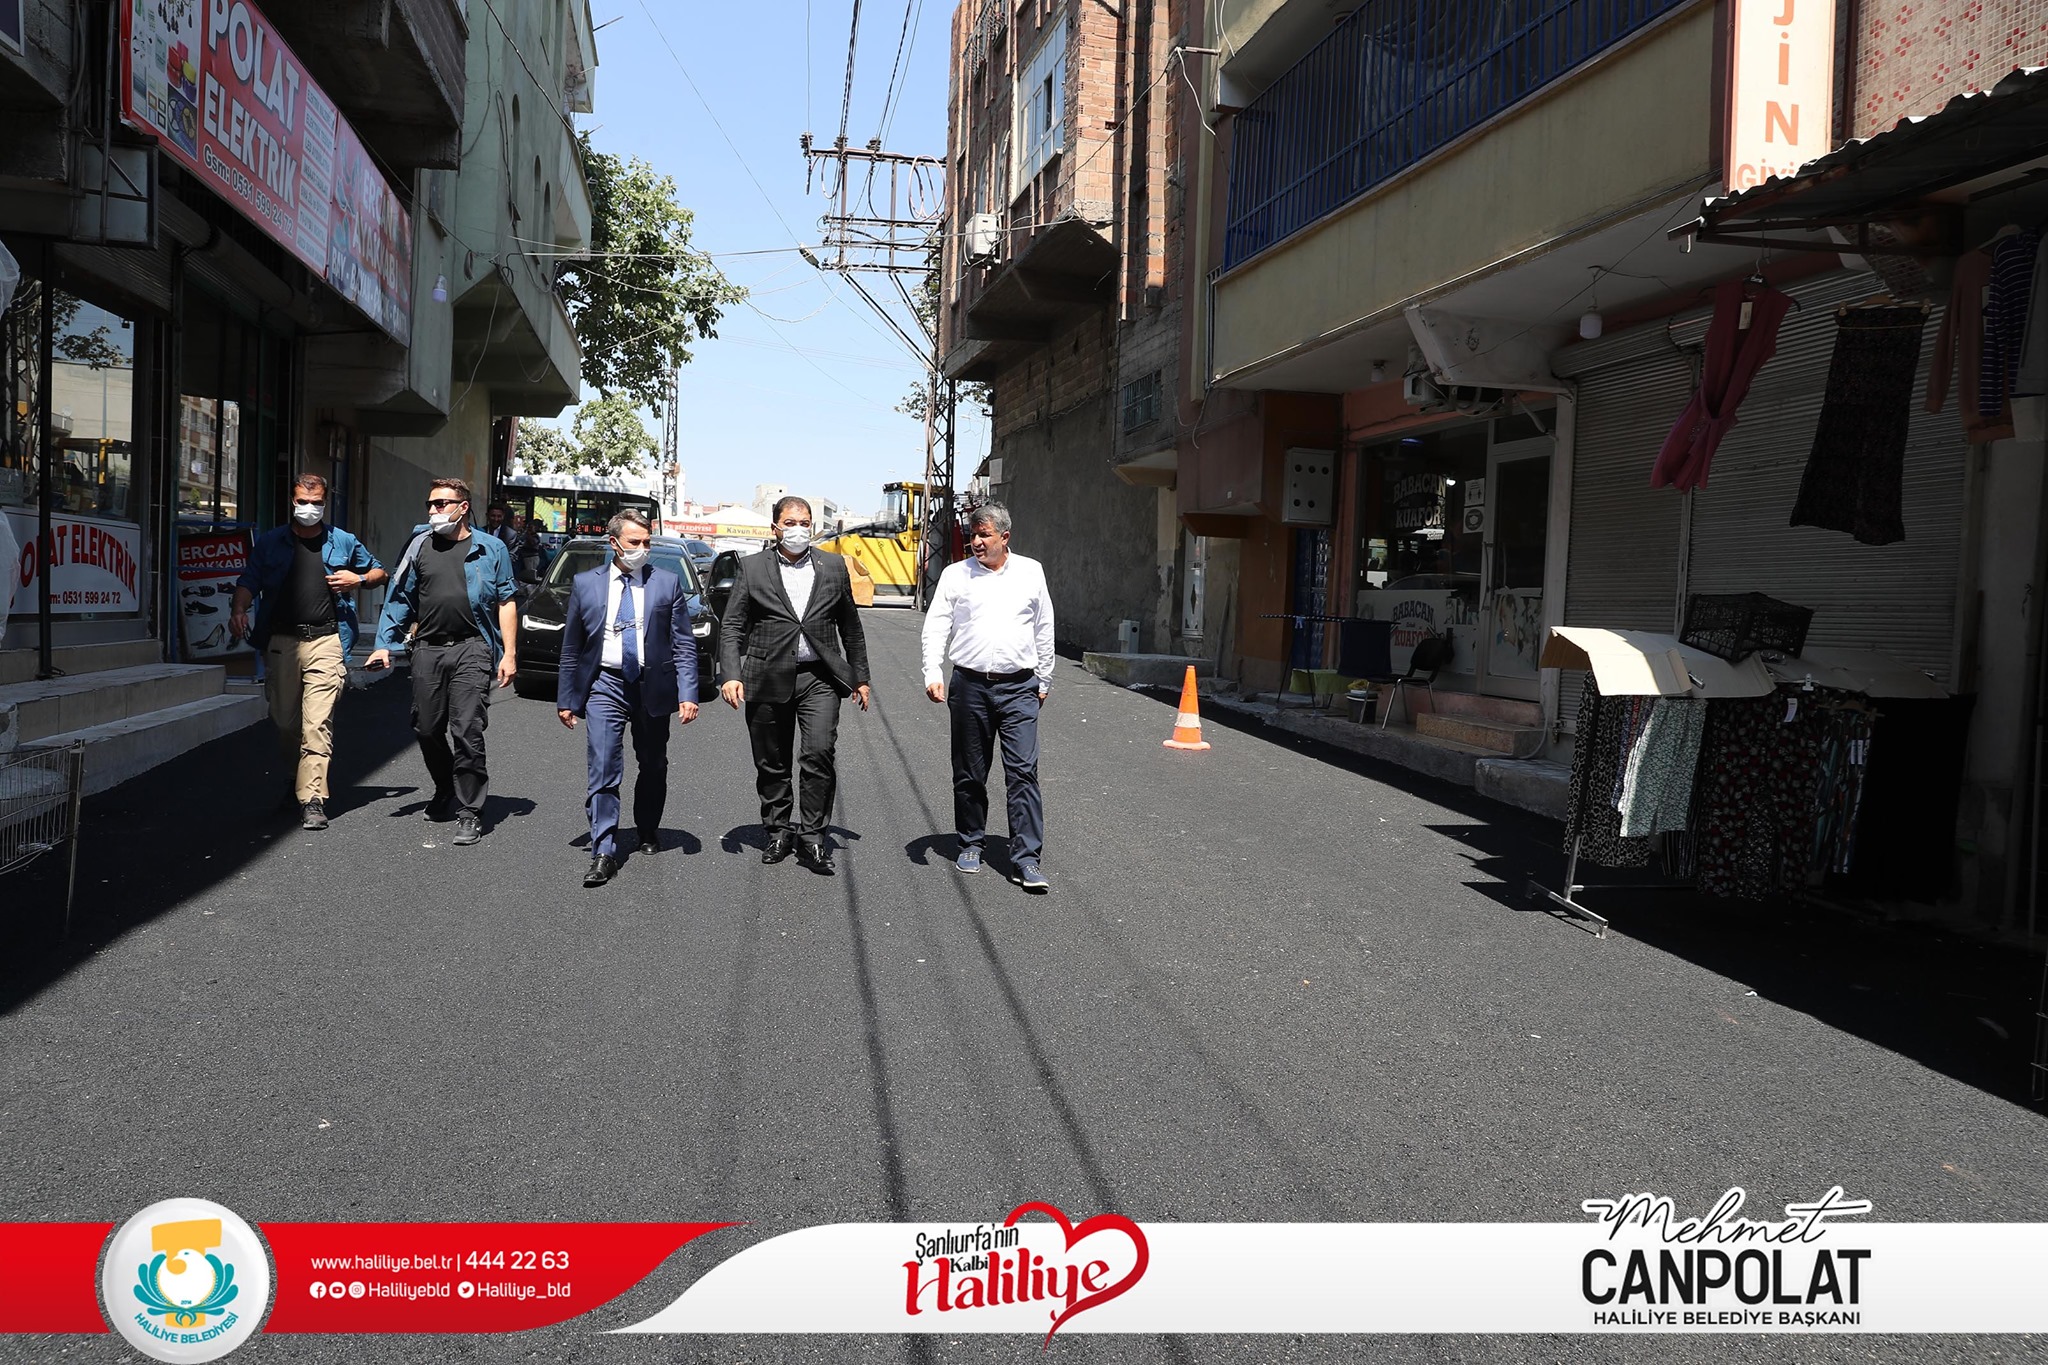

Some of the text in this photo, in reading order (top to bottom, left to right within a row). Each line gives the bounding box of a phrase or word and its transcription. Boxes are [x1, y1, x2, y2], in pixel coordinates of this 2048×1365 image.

[207, 0, 300, 133] POLAT
[203, 72, 298, 209] ELEKTRİK
[204, 144, 231, 184] Gsm:
[231, 167, 254, 205] 0531
[256, 188, 271, 219] 599
[272, 204, 283, 229] 24
[283, 213, 294, 239] 72
[332, 245, 346, 282] BAY
[1393, 473, 1446, 503] BABACAN
[752, 528, 775, 537] Karp
[72, 524, 137, 600] ELEKTRİK
[180, 541, 244, 560] ERCAN
[63, 591, 82, 604] 0531
[85, 592, 98, 604] 599
[101, 592, 110, 604] 24
[112, 592, 120, 604] 72
[1393, 600, 1434, 625] BABACAN
